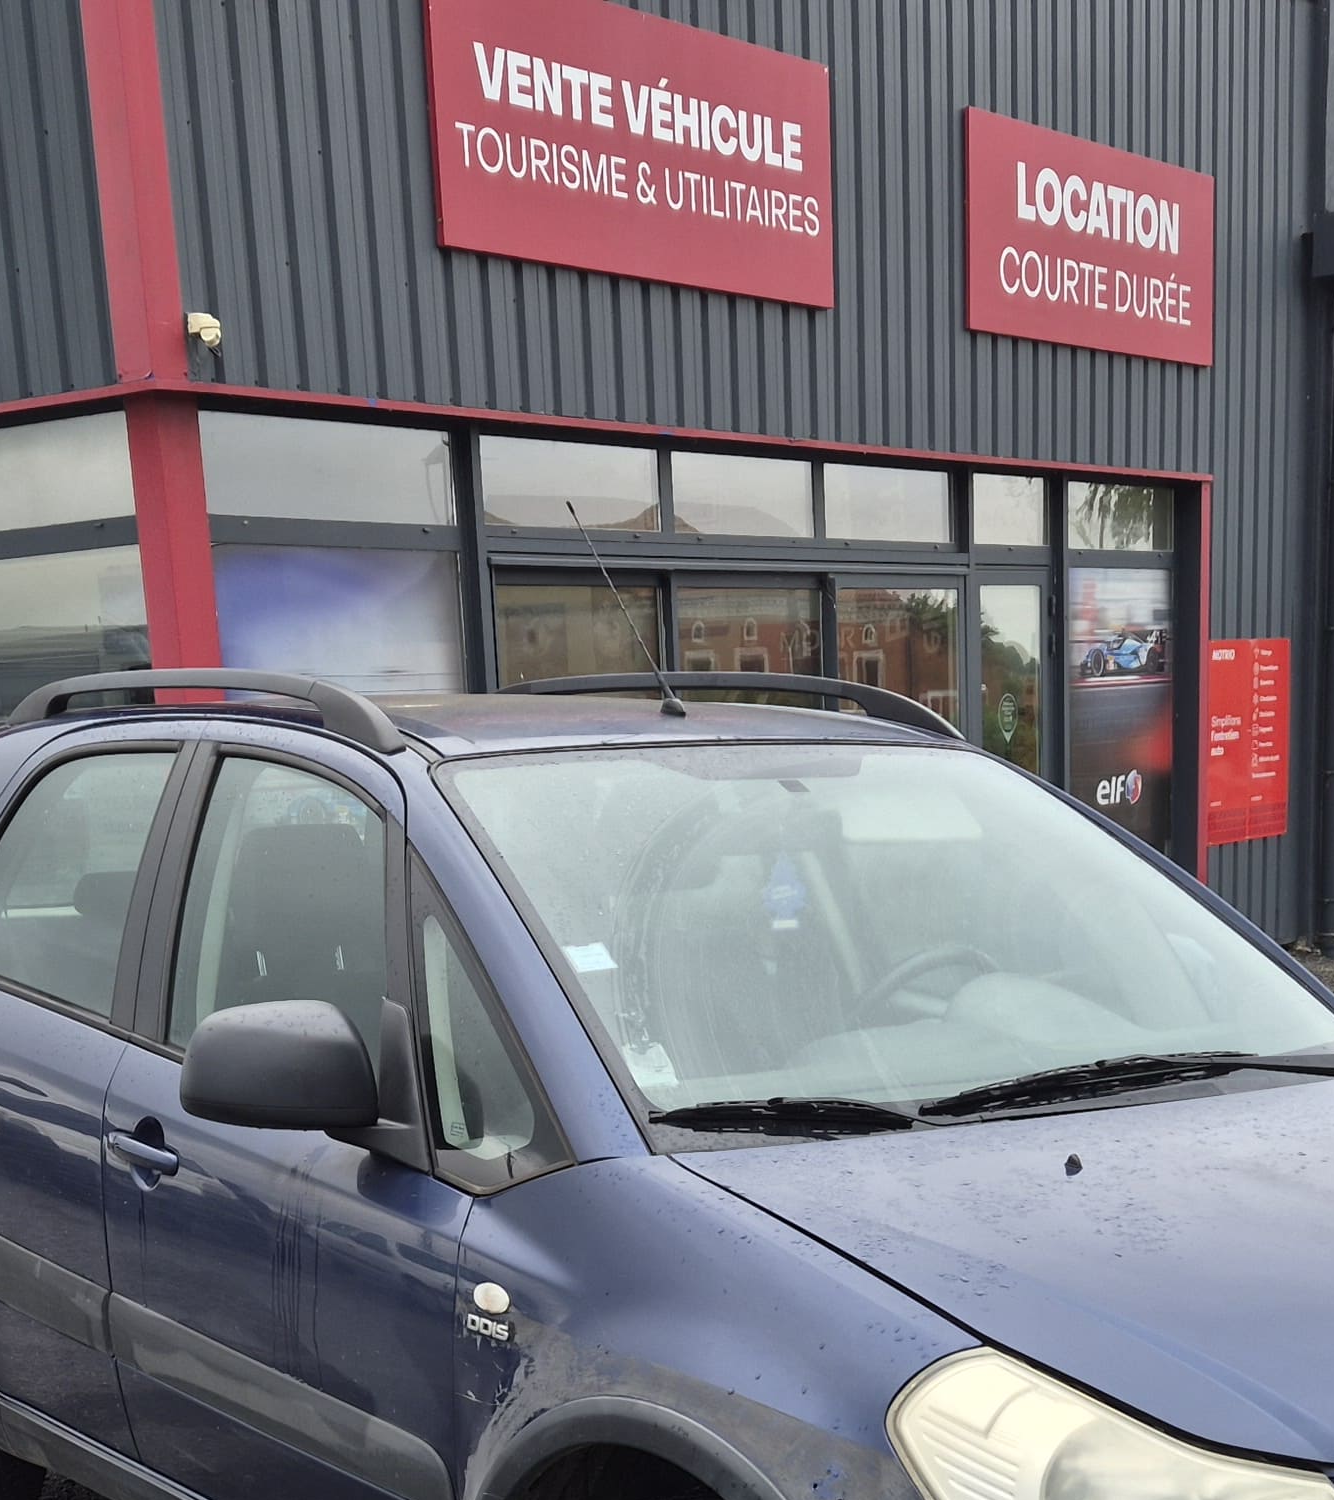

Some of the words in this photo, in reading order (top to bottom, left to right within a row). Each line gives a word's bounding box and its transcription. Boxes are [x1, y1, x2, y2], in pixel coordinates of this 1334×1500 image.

[472, 41, 614, 129] VENTE
[621, 77, 803, 172] VÉHICULE
[454, 121, 628, 199] TOURISME
[636, 161, 657, 205] &
[665, 168, 820, 237] UTILITAIRES
[1017, 161, 1180, 255] LOCATION
[999, 246, 1108, 310] COURTE
[1115, 273, 1191, 326] DURÉE
[1096, 775, 1126, 805] elf
